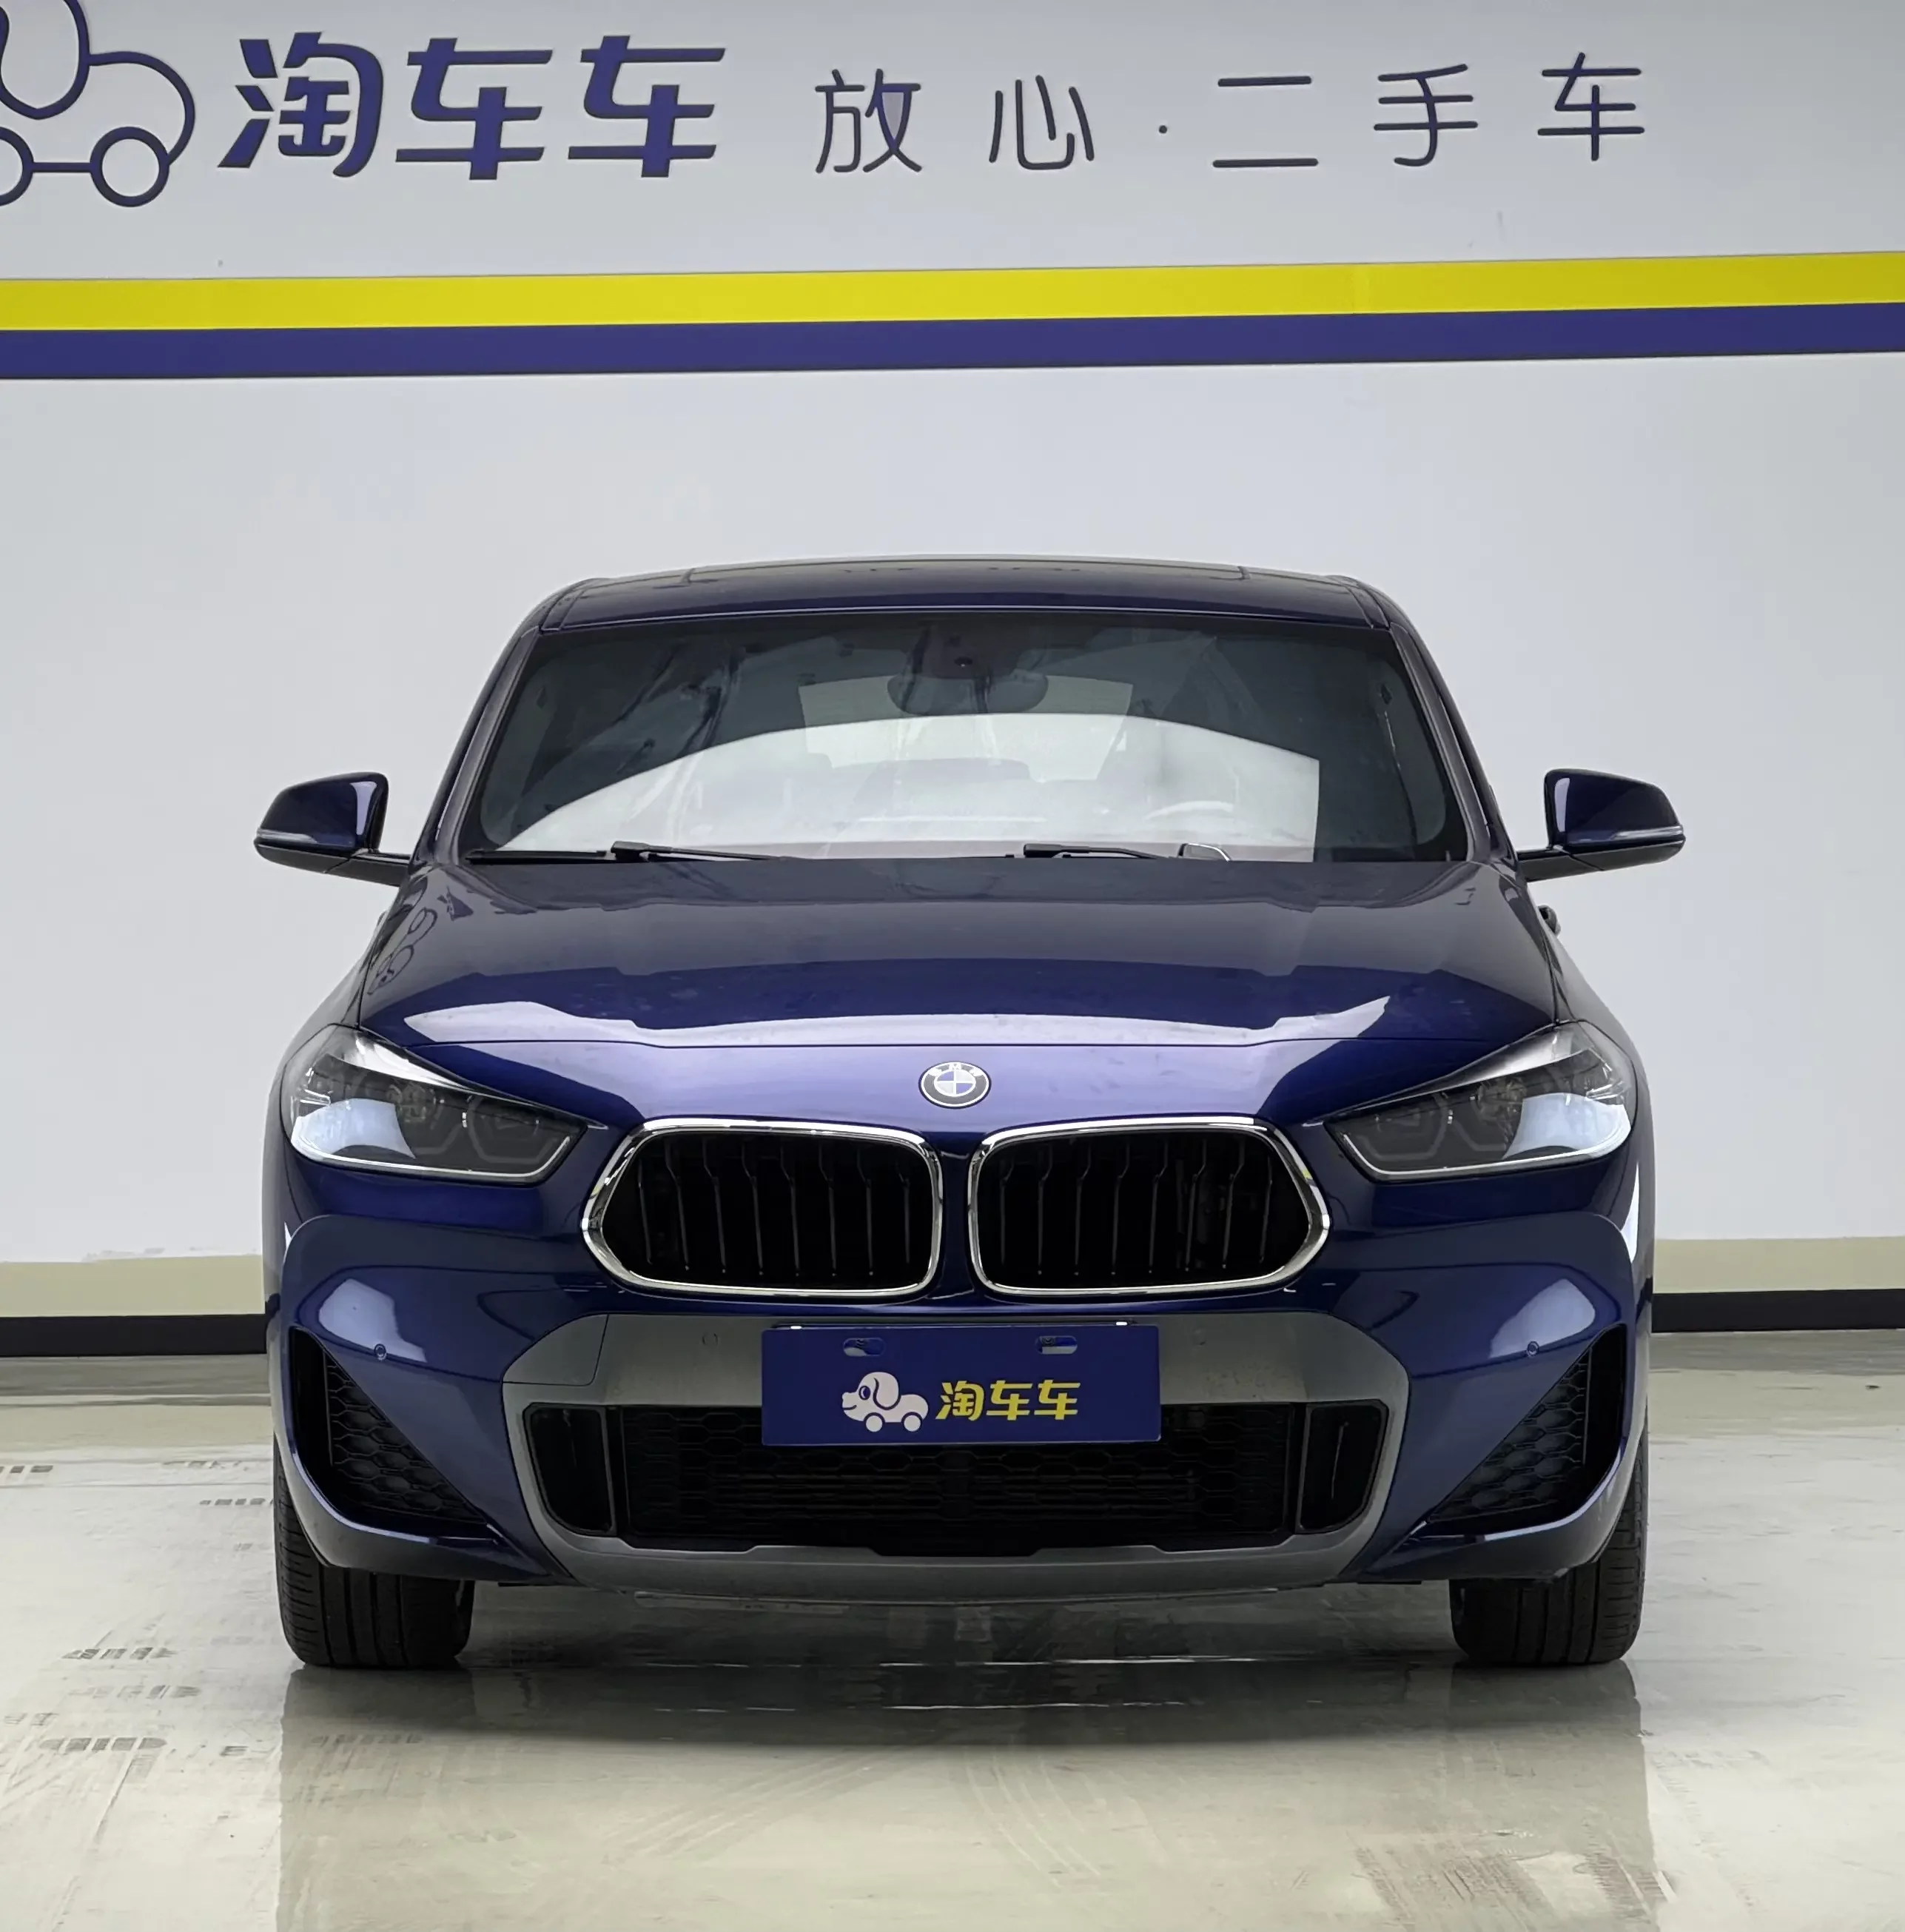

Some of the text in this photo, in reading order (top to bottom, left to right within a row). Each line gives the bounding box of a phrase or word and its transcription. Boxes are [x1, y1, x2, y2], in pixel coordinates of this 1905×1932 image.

[218, 31, 726, 181] 淘车车
[935, 1379, 1081, 1421] 淘车车
